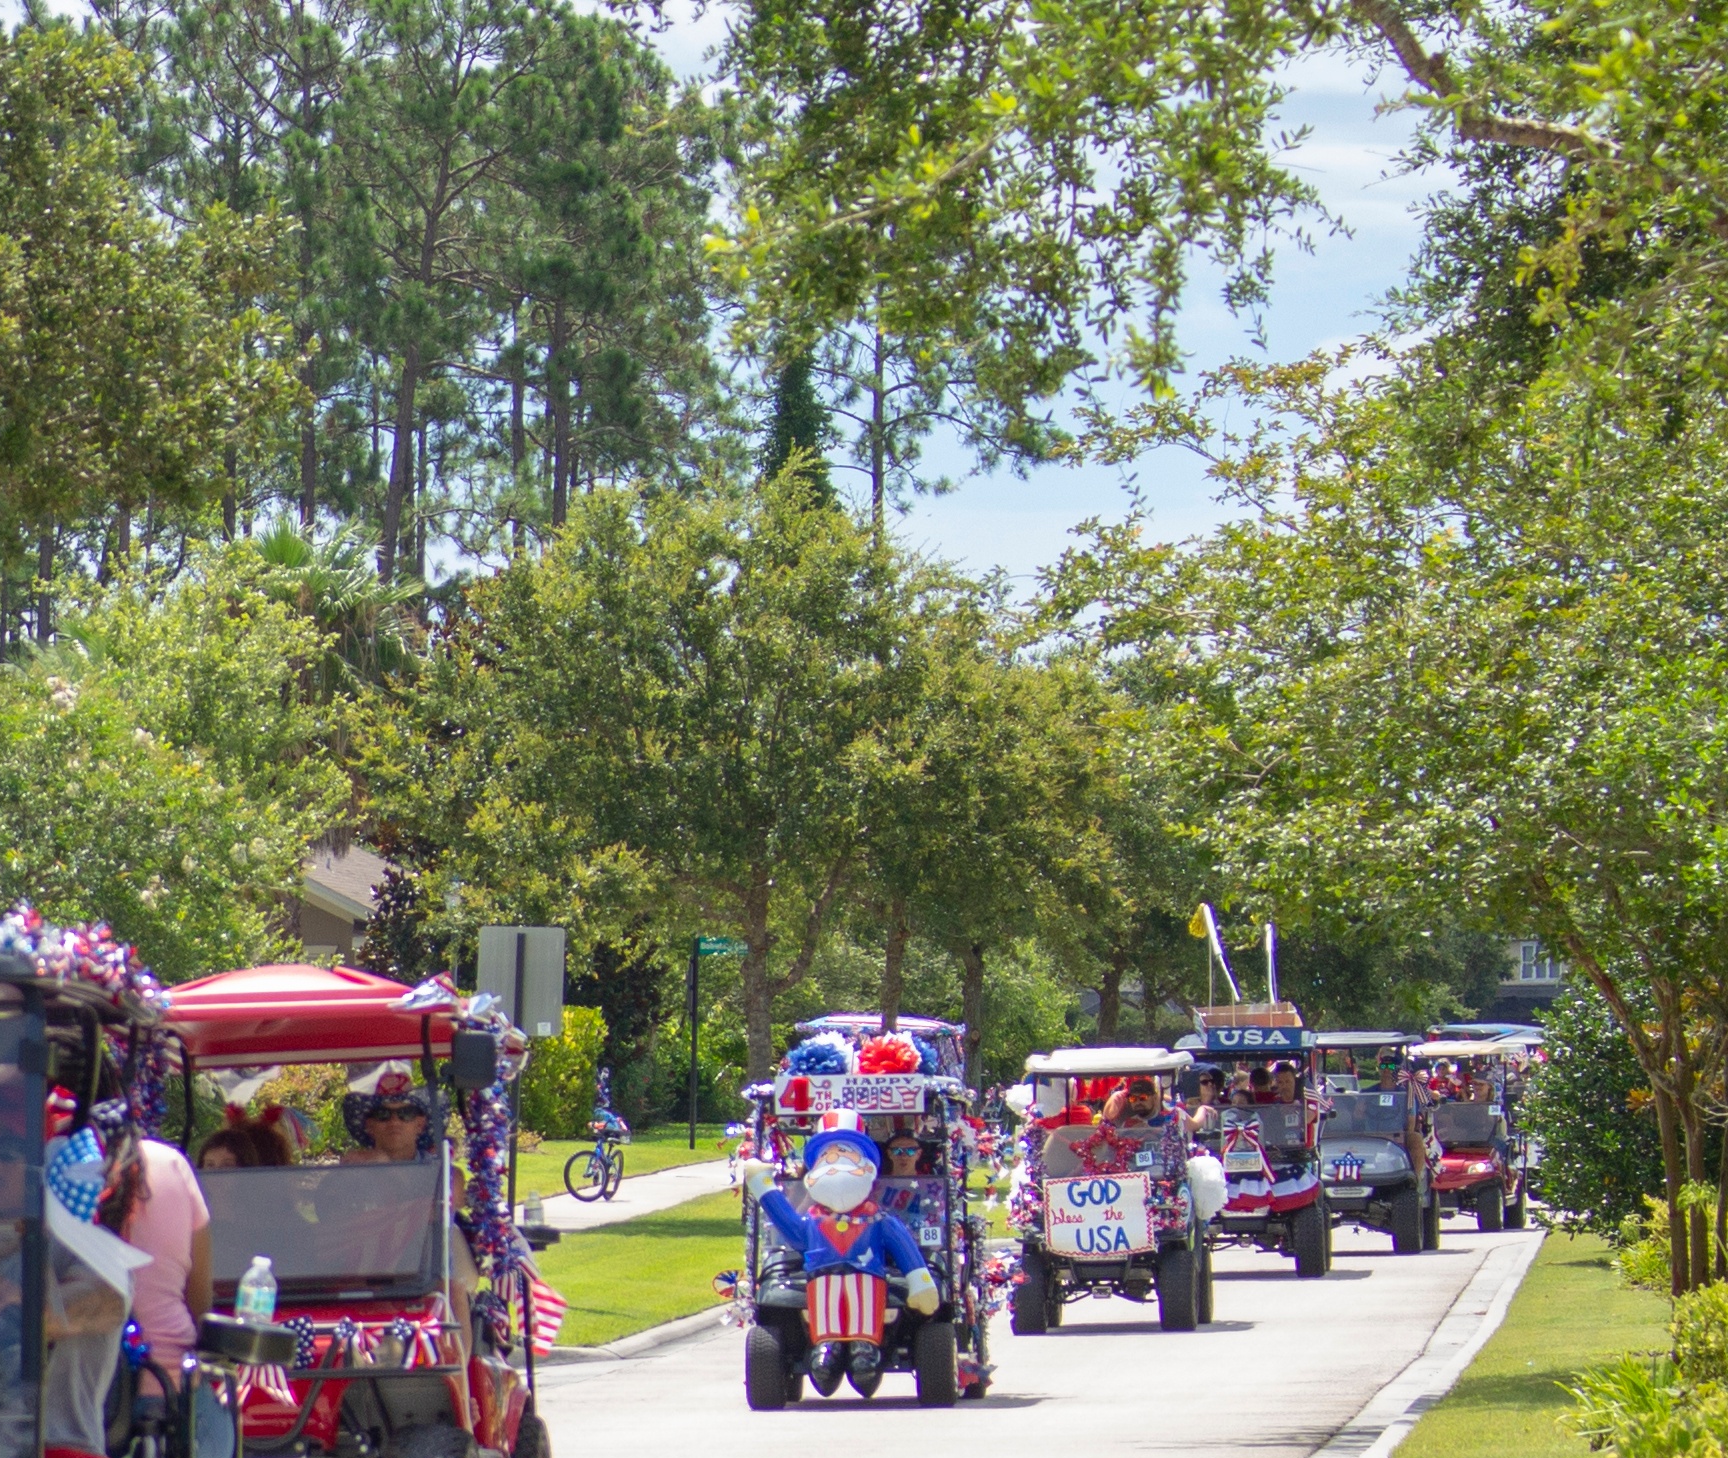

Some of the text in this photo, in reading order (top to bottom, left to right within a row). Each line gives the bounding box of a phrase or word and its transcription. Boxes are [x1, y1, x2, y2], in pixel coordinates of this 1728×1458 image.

[1217, 1029, 1290, 1045] USA
[845, 1077, 915, 1085] HAPPY
[815, 1090, 832, 1100] TH
[833, 1086, 922, 1111] JULY
[815, 1101, 831, 1111] OF
[882, 1186, 920, 1214] USA
[1067, 1179, 1121, 1207] GOD
[1051, 1206, 1124, 1225] bless the
[924, 1229, 938, 1241] 88
[1076, 1225, 1130, 1253] USA
